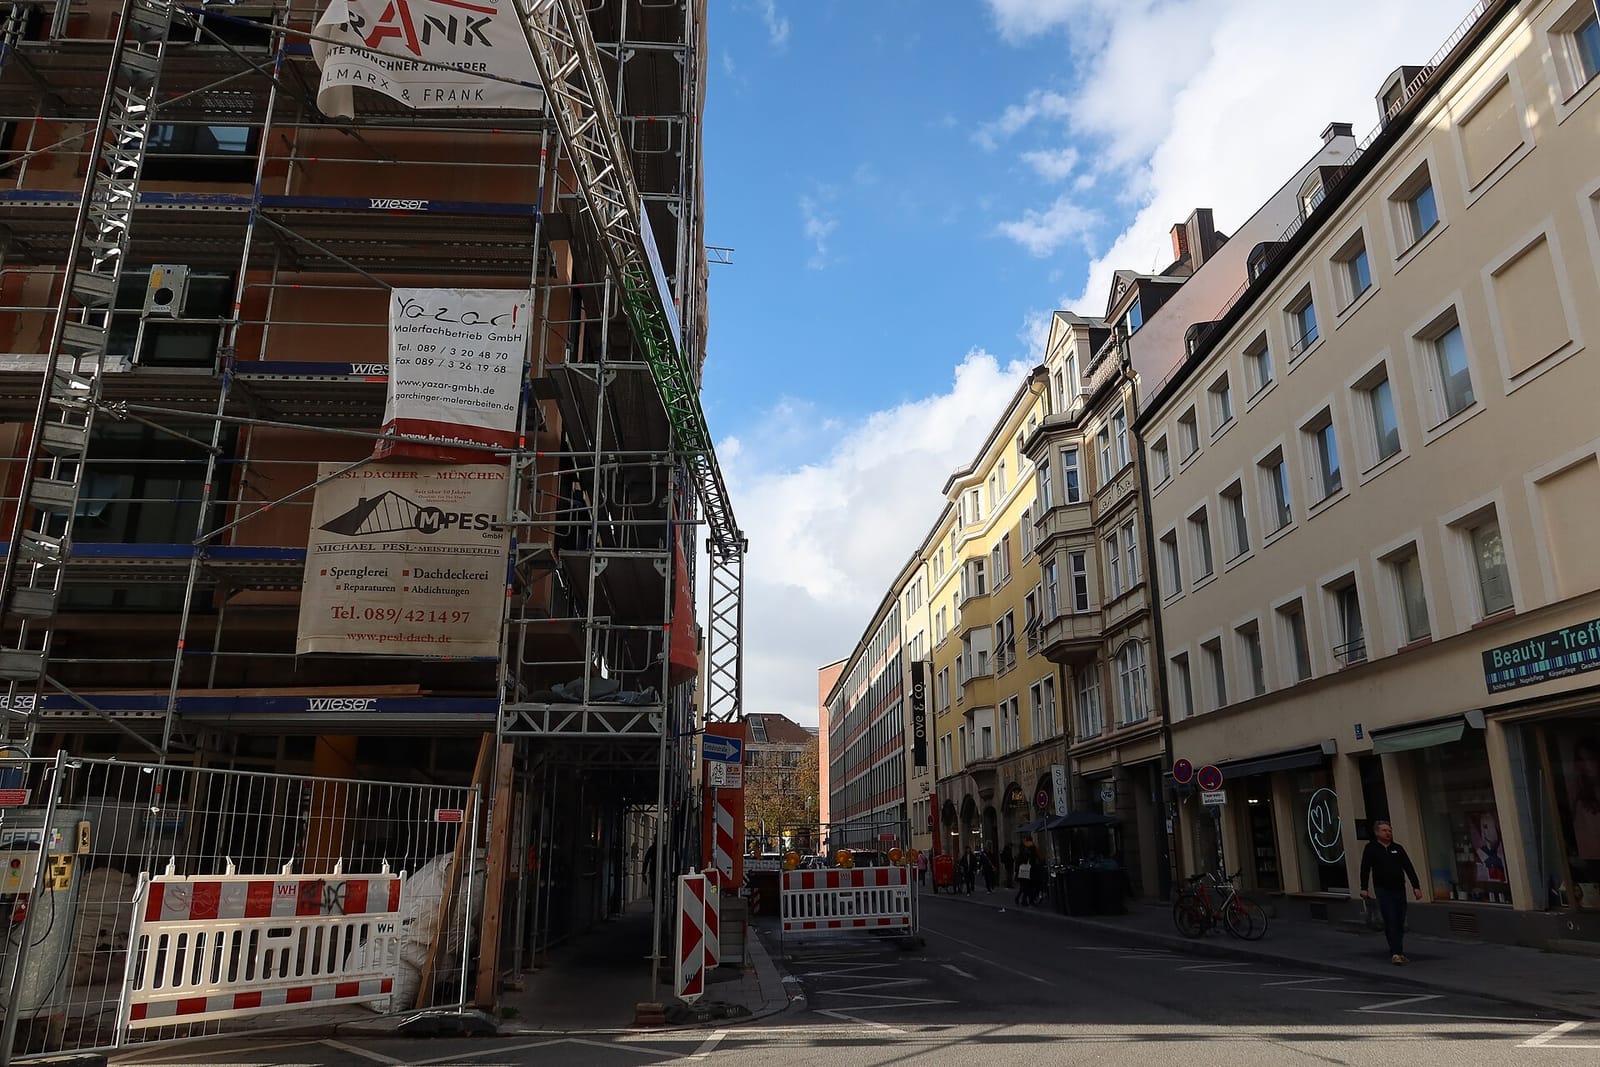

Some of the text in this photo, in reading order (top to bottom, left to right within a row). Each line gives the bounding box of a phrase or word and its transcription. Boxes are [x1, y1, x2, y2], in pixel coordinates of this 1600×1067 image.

[401, 89, 411, 101] &
[423, 88, 484, 102] FRANK
[394, 324, 522, 343] Malerfachbetrieb GmbH
[397, 343, 508, 361] Tel. 089 / 3 20 48 70
[395, 357, 507, 375] Fax 089 / 3 26 19 68
[396, 379, 495, 396] www.yazar-gmbh.de
[395, 393, 514, 412] garchinger-malerarbeiten.de
[436, 469, 505, 480] MÜNCHEN
[482, 532, 503, 540] GmbH
[317, 543, 376, 552] MICHAEL
[382, 543, 414, 551] PESL
[329, 566, 489, 581] Spenglerei Dachdeckerei
[343, 582, 470, 597] Reparaturen Abdichtungen
[331, 605, 361, 620] Tel.
[346, 631, 451, 644] www.pesl-dach.de
[1492, 640, 1546, 669] Beauty
[278, 885, 297, 895] WH
[377, 923, 394, 933] WH
